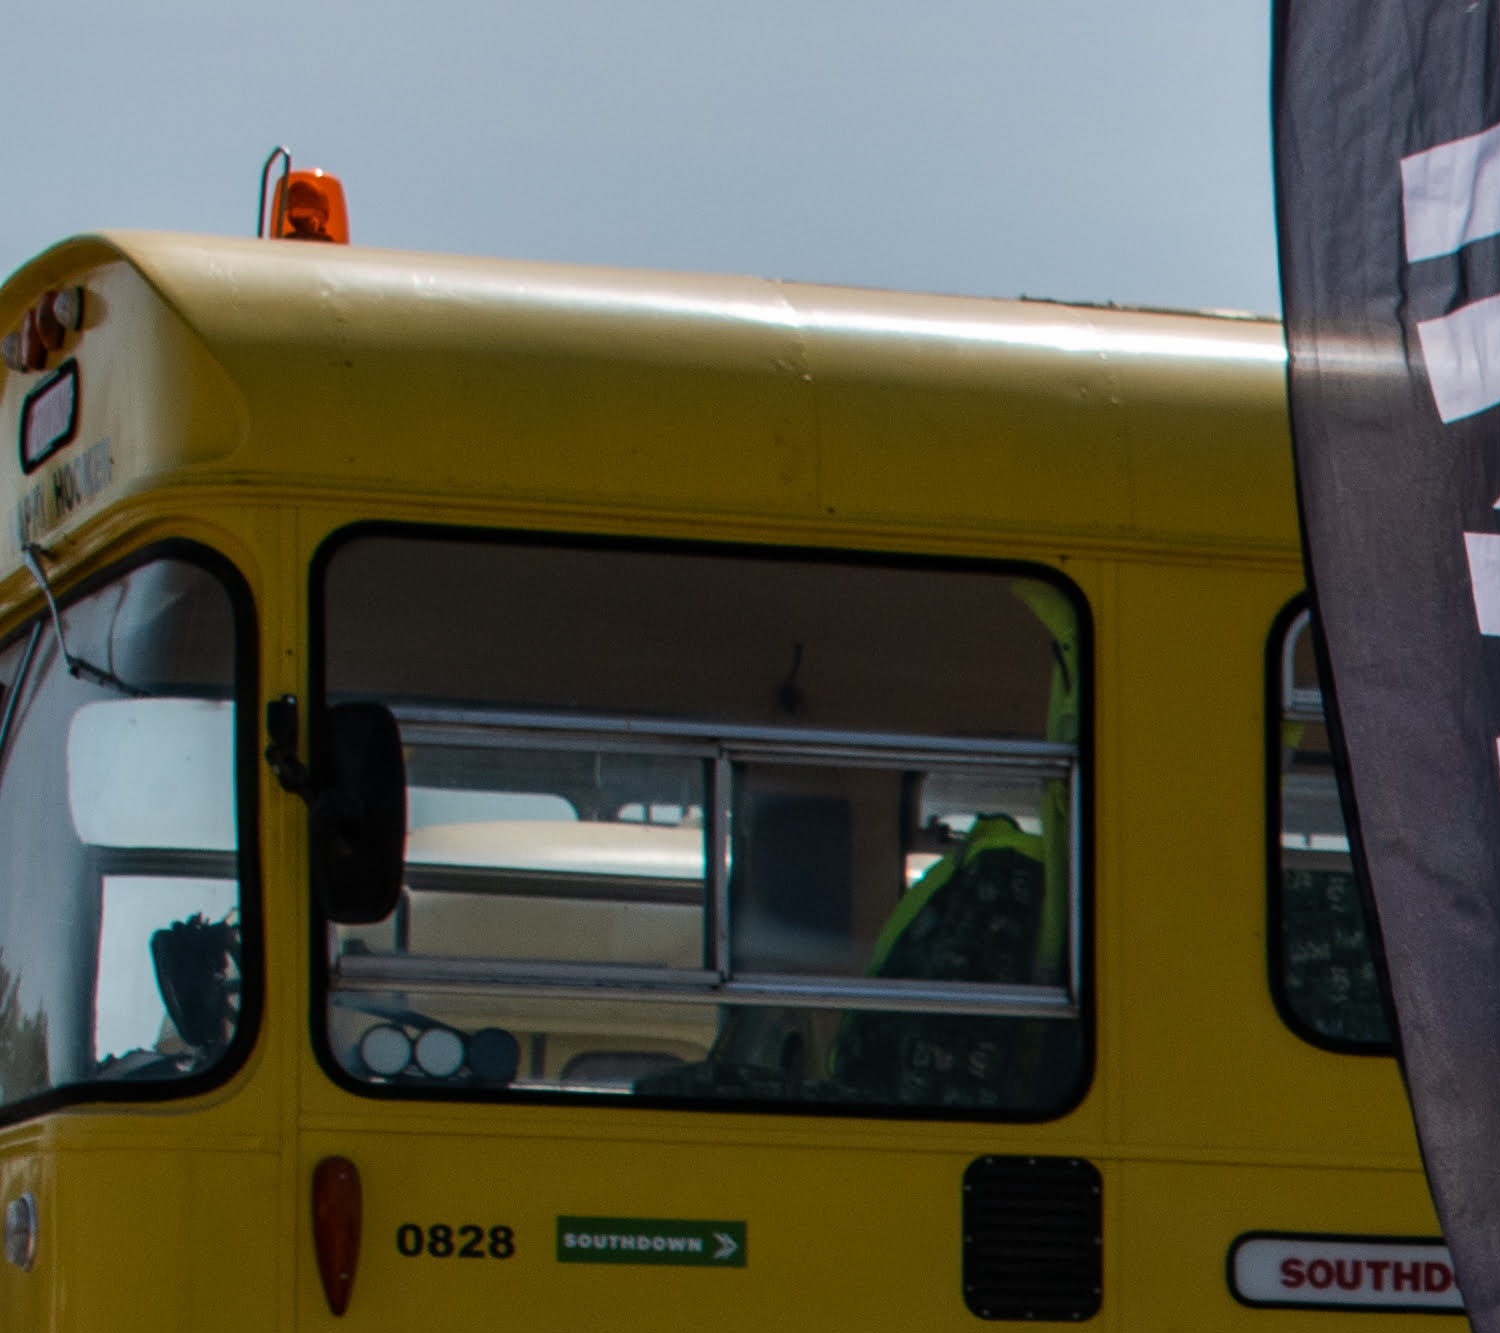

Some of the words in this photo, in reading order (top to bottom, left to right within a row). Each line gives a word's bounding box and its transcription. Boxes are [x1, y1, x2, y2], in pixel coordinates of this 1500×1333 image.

[395, 1221, 516, 1261] 0828
[563, 1232, 704, 1253] SOUTHDOWN
[1280, 1258, 1458, 1293] SOUTHD
